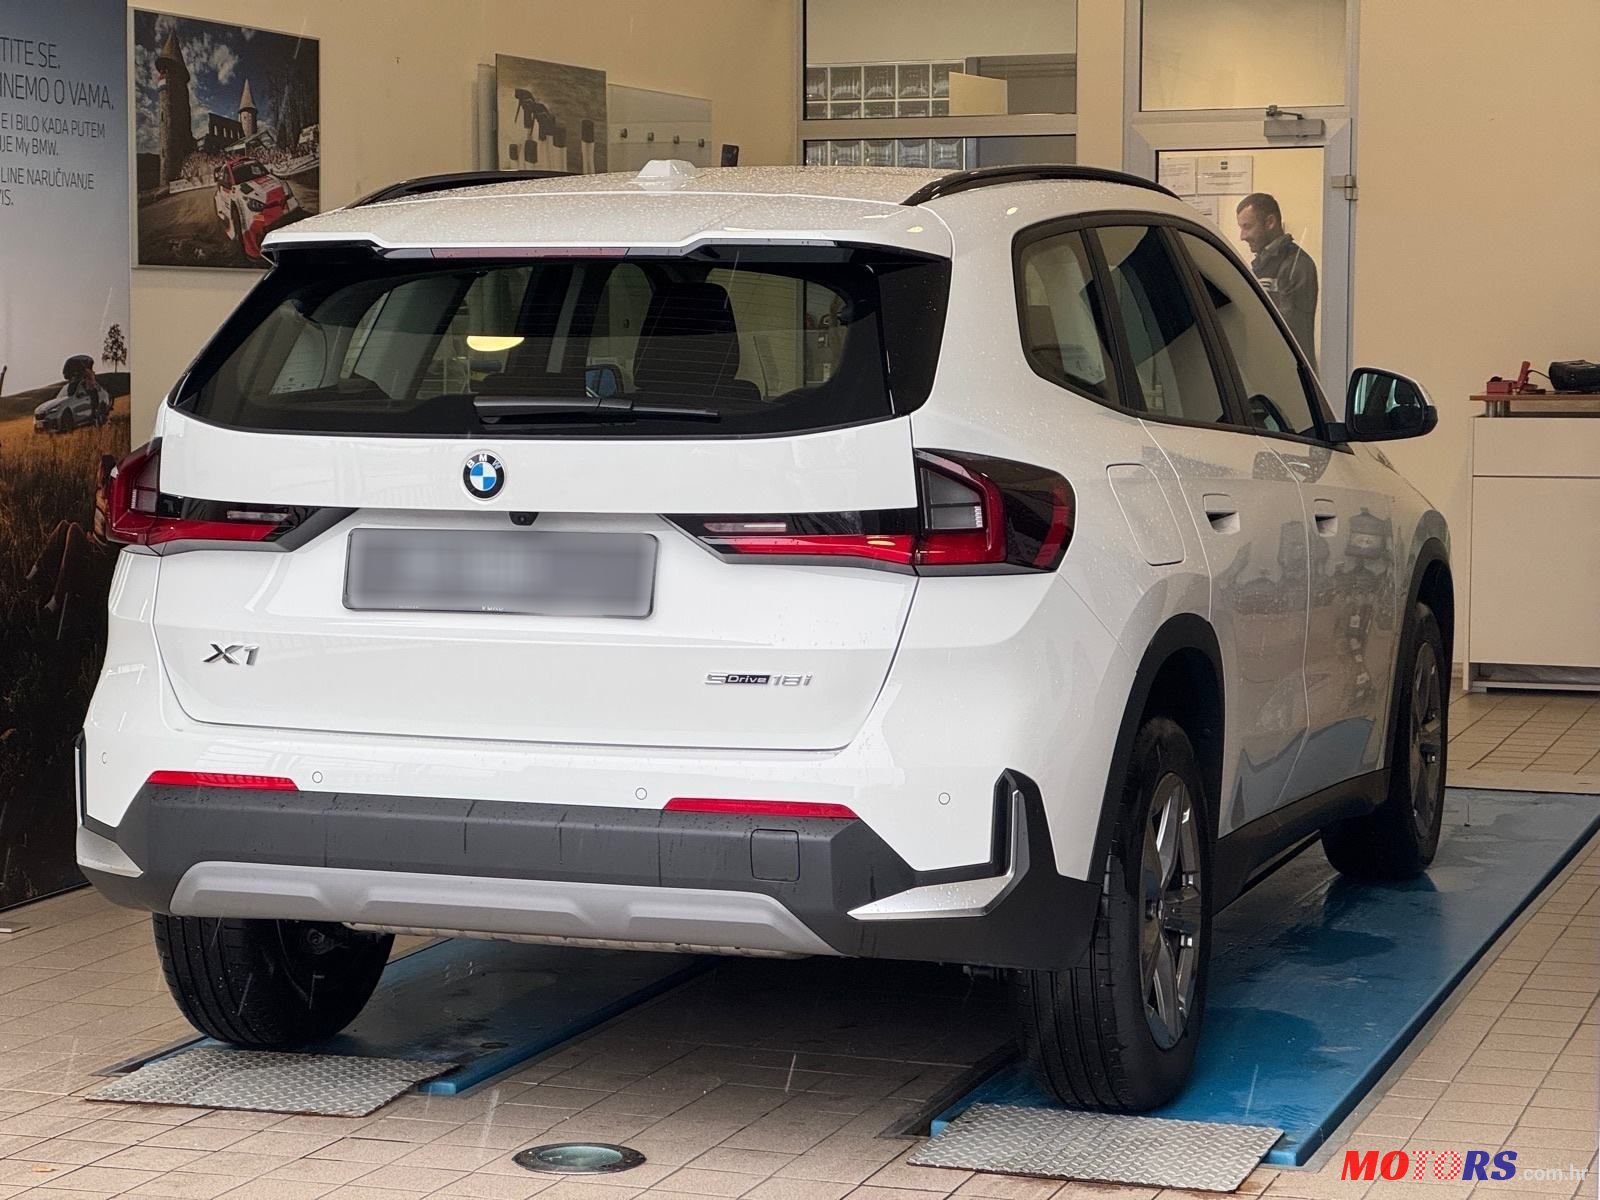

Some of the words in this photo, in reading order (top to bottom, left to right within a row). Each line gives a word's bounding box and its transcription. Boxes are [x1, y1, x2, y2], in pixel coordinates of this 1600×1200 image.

[54, 79, 65, 105] O
[68, 81, 114, 110] VAMA.
[16, 114, 40, 132] BILO
[41, 116, 69, 135] KADA
[71, 120, 106, 139] PUTEM
[15, 136, 30, 157] My
[31, 138, 59, 156] BMW.
[26, 167, 95, 190] NARUČIVANJE
[466, 453, 502, 470] BMW
[202, 643, 260, 667] X1
